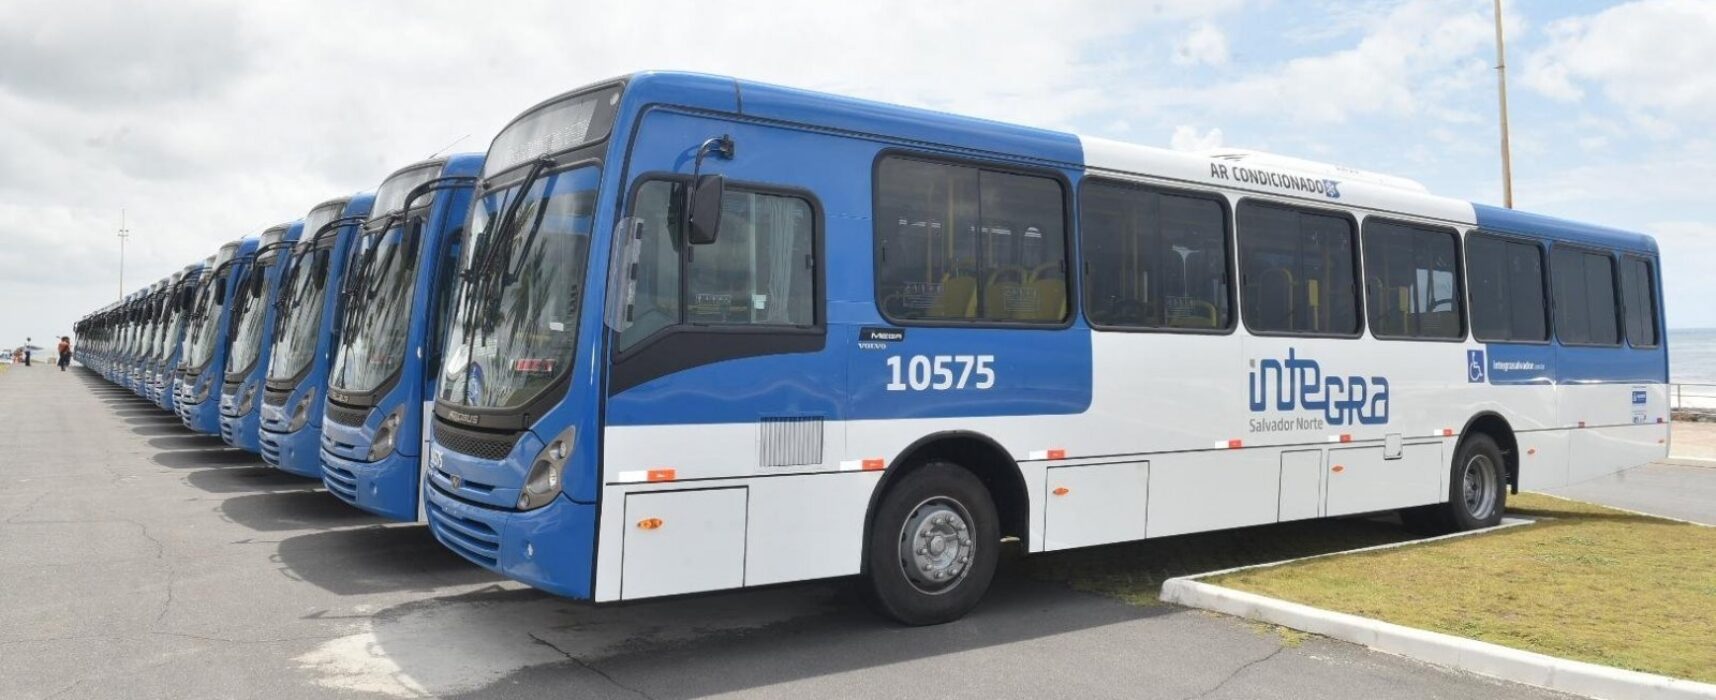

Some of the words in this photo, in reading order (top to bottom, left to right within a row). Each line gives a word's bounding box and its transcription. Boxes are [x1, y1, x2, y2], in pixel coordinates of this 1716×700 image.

[1210, 162, 1229, 180] AR
[1232, 166, 1324, 194] CONDICIONADO
[858, 342, 887, 350] VOLVO
[886, 354, 995, 391] 10575
[1249, 417, 1294, 433] Salvador
[1296, 417, 1323, 431] Norte
